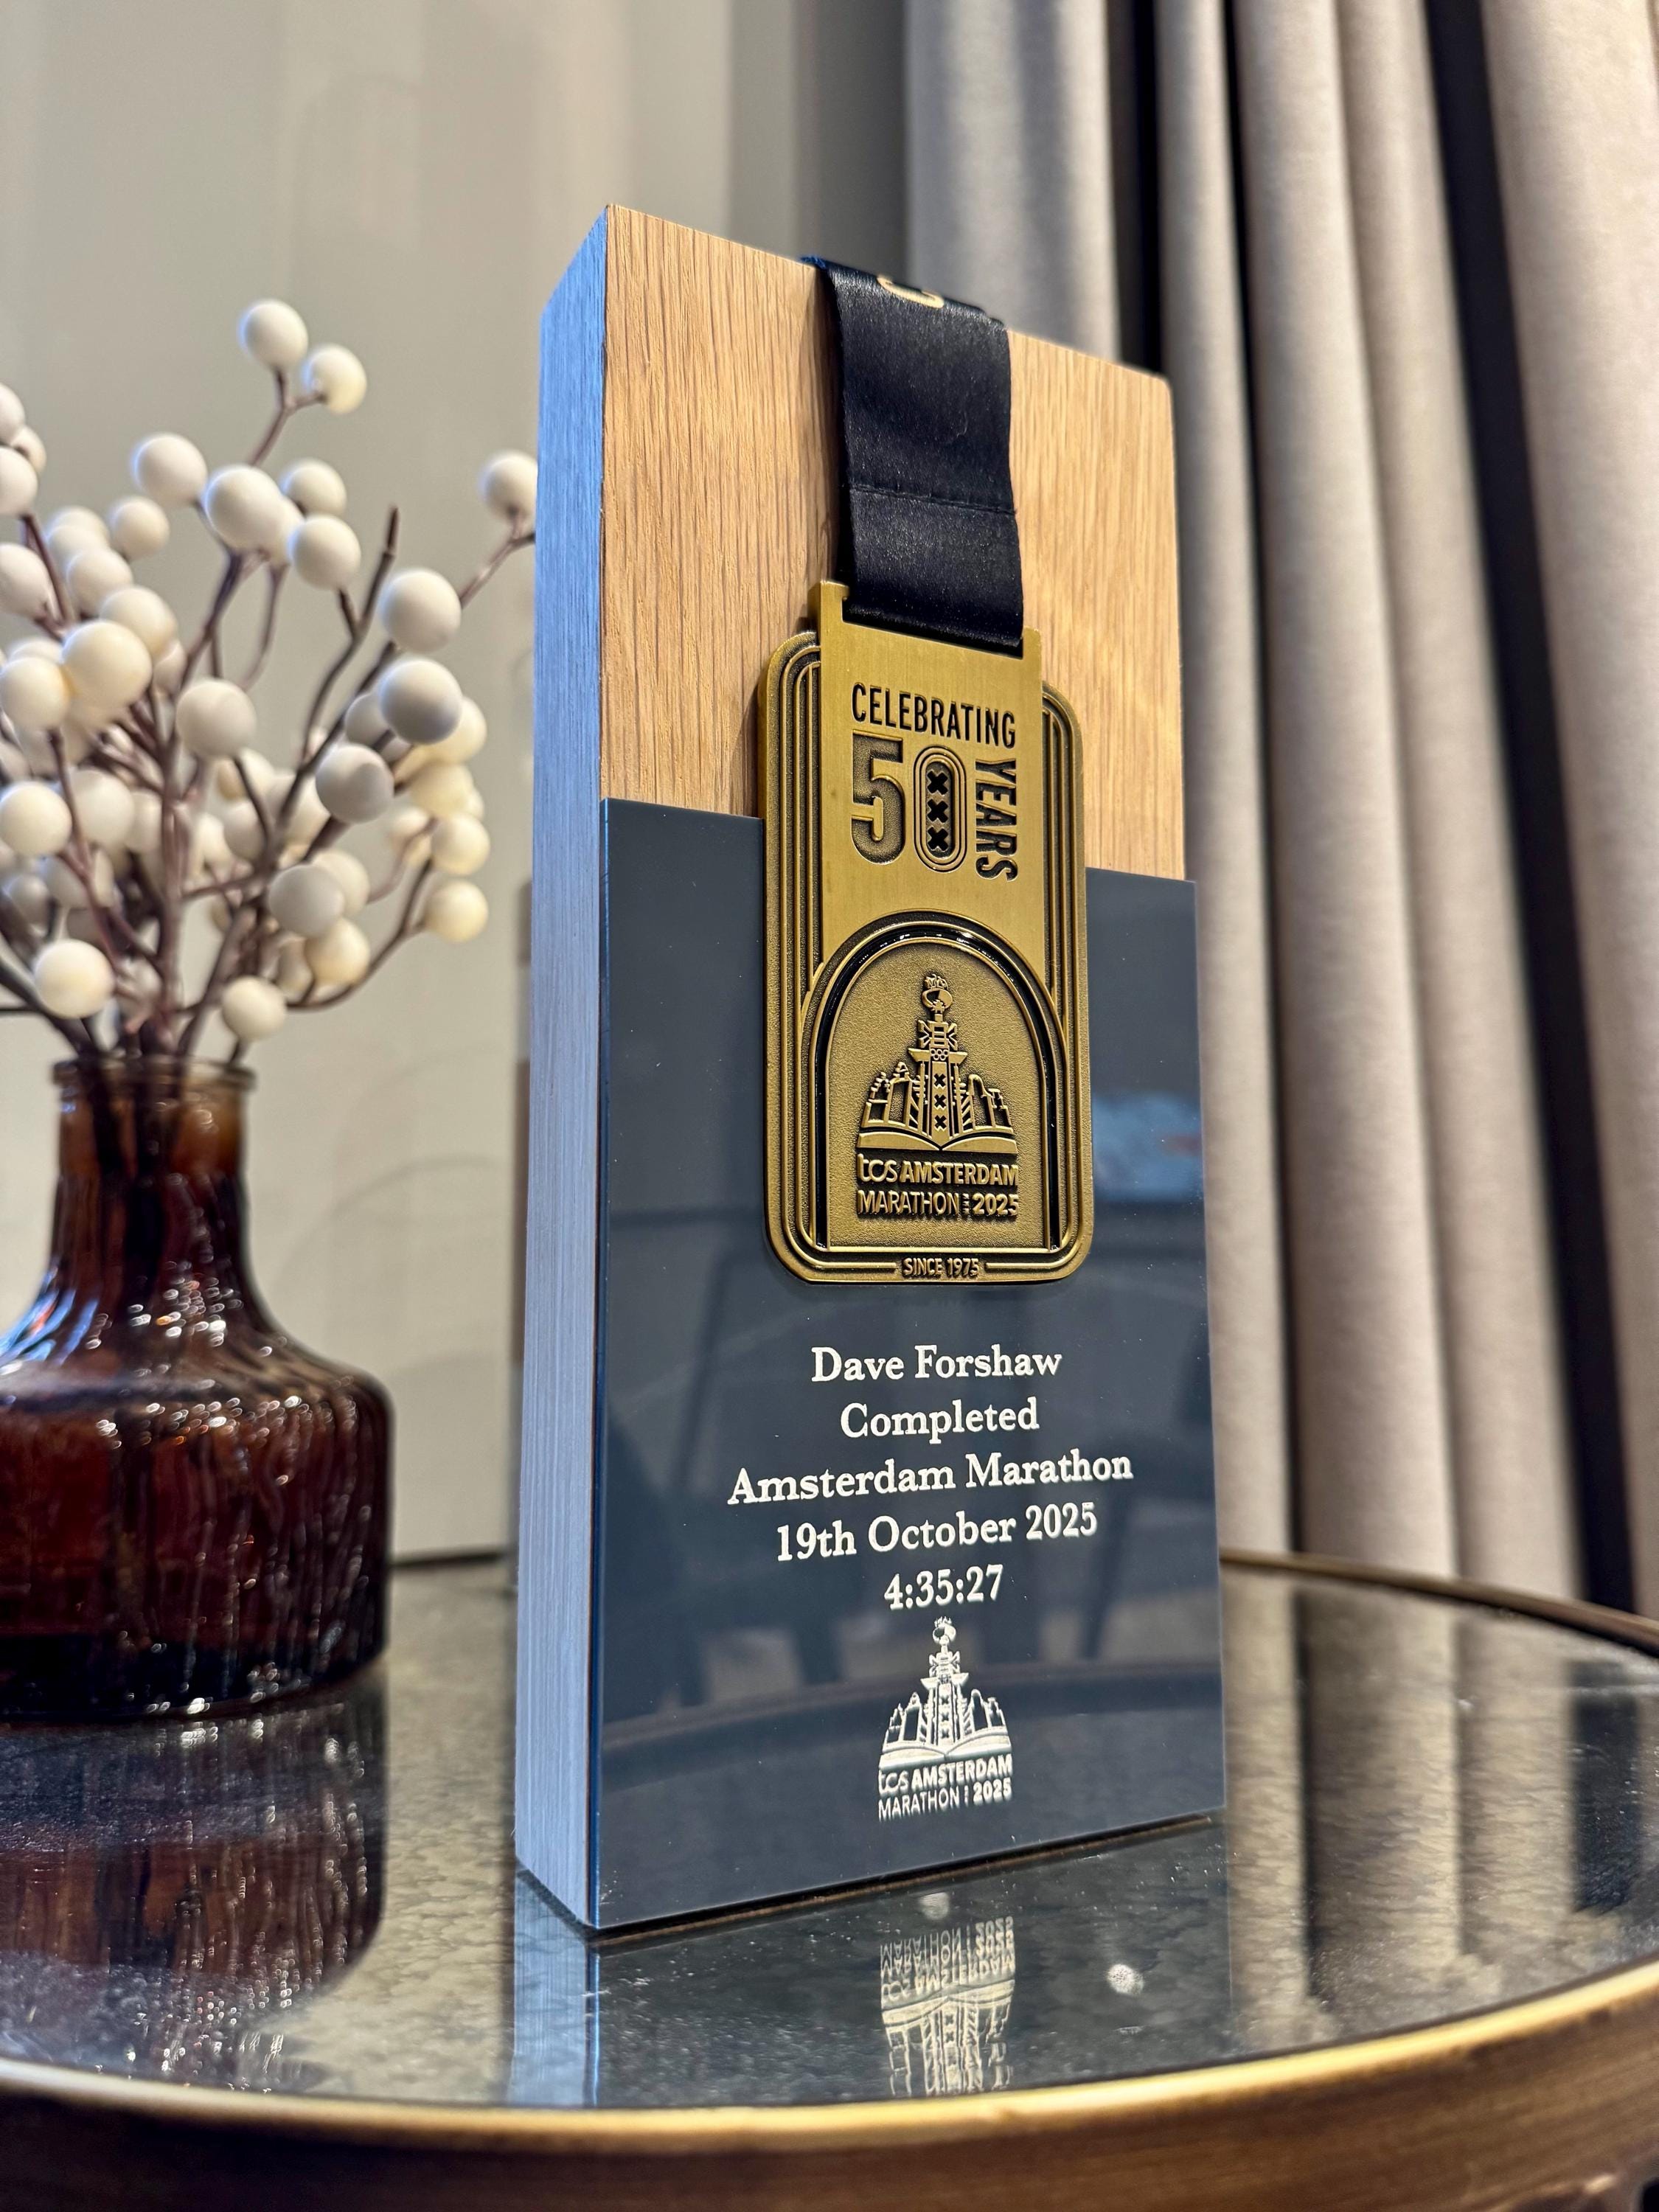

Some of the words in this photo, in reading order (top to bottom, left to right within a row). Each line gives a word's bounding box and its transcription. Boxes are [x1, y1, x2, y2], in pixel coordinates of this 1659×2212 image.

[852, 681, 1016, 749] CELEBRATING
[851, 728, 967, 873] 50
[975, 758, 1018, 882] YEARS
[900, 1160, 1019, 1186] AMSTERDAM
[857, 1189, 959, 1216] MARATHON
[972, 1192, 1019, 1217] 2025
[903, 1256, 942, 1277] SINCE
[947, 1256, 980, 1278] 1975
[811, 1346, 905, 1382] Dave
[914, 1343, 1062, 1380] Forshaw
[840, 1396, 1040, 1444] Completed
[727, 1458, 956, 1505] Amsterdam
[964, 1447, 1134, 1489] Marathon
[776, 1519, 857, 1561] 19th
[867, 1510, 1018, 1552] October
[1025, 1500, 1098, 1540] 2025
[883, 1563, 1004, 1610] 4:35:27
[911, 1753, 1013, 1792] AMSTERDAM
[878, 1786, 960, 1822] MARATHON
[973, 1777, 1012, 1805] 2025
